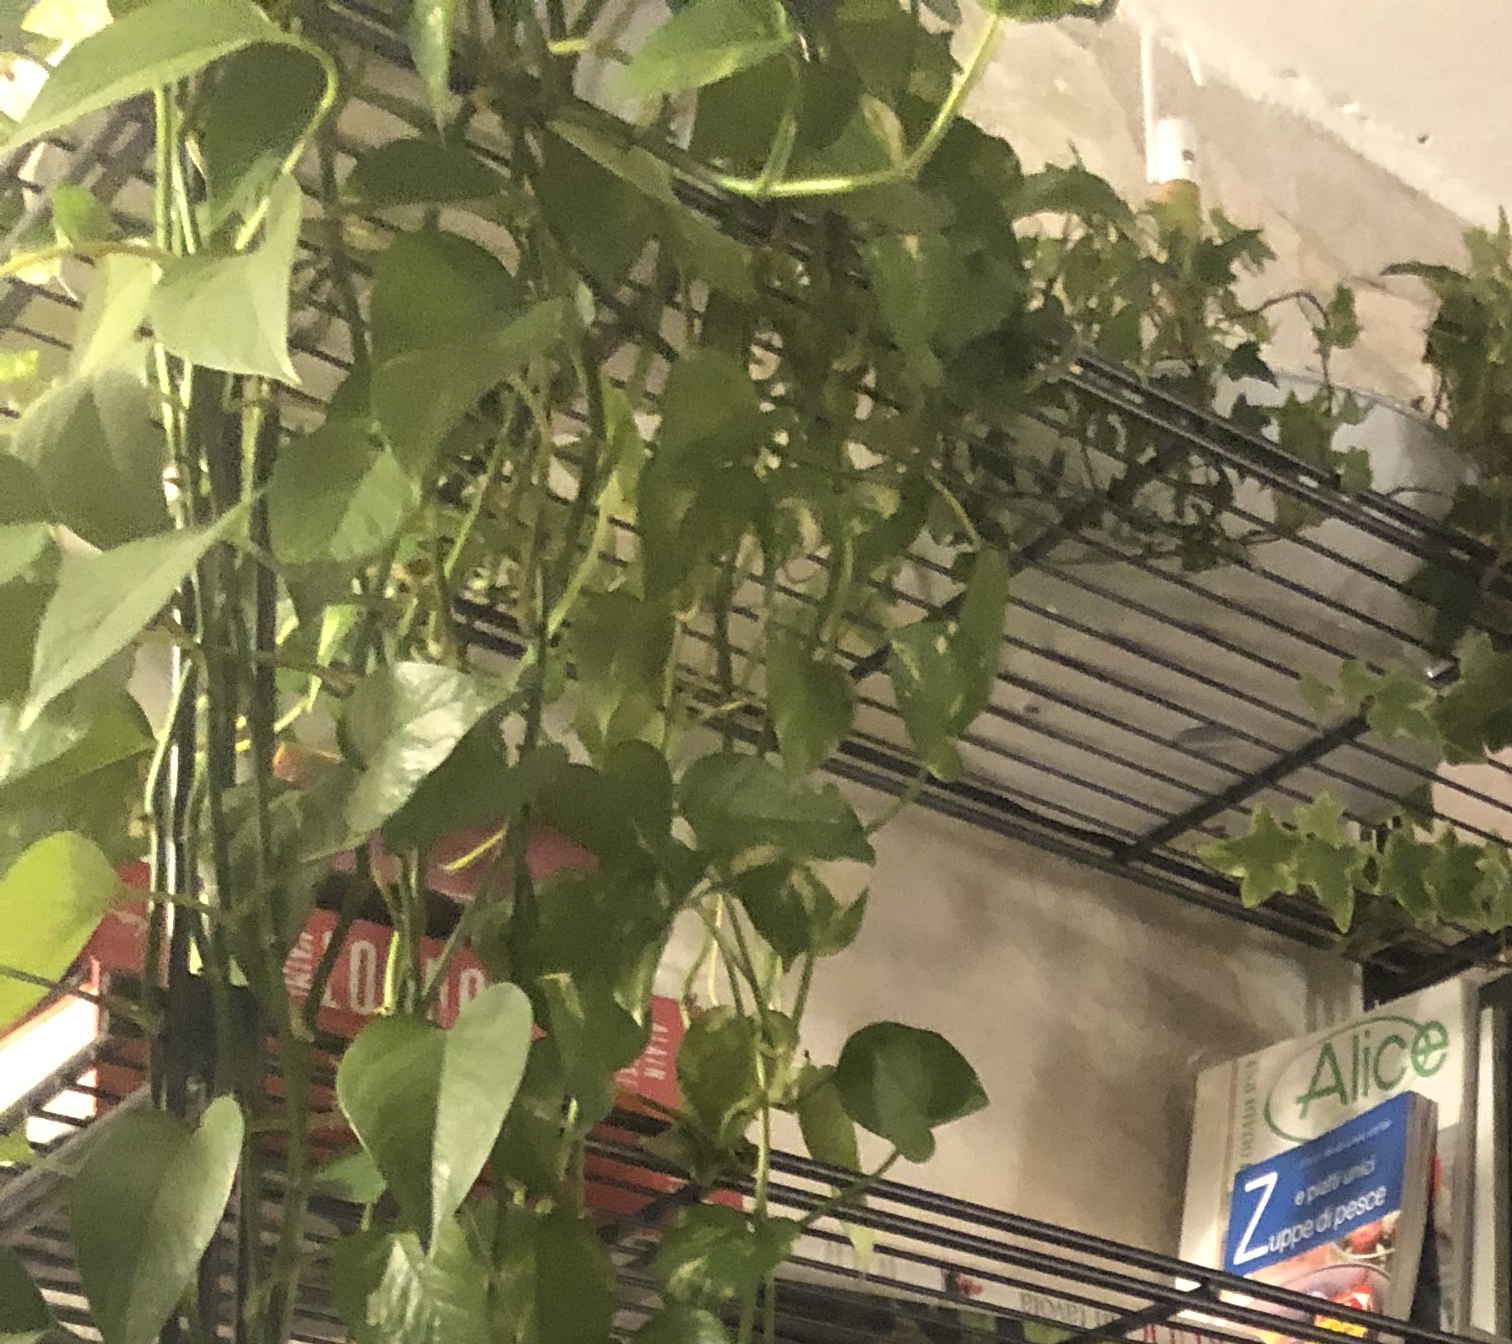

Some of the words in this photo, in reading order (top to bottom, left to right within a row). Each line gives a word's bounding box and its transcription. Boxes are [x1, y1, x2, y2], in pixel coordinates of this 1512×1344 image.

[1296, 1020, 1449, 1119] Alice
[1233, 1171, 1314, 1265] Zuppe
[1316, 1206, 1331, 1233] di
[1332, 1185, 1387, 1231] pesce
